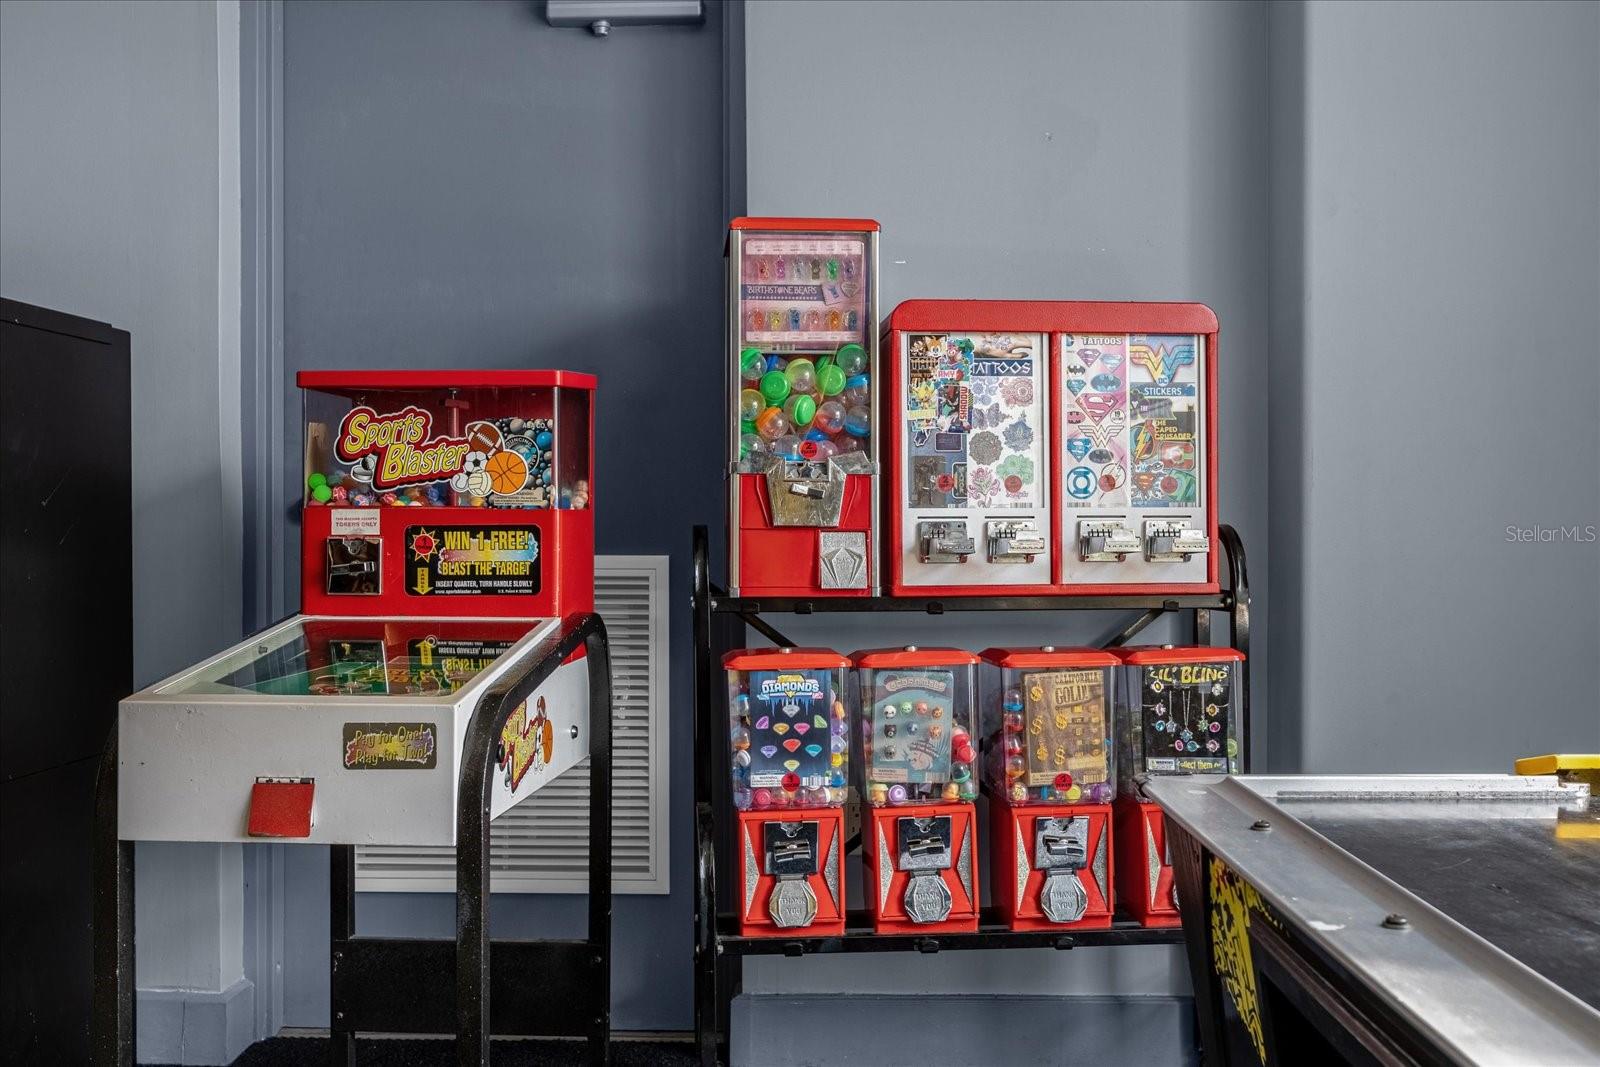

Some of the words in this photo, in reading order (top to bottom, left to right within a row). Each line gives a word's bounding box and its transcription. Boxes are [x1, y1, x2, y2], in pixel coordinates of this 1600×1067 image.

[794, 286, 818, 296] BEARS
[1082, 336, 1122, 346] TATTOOS
[971, 361, 1031, 375] TATTOOS
[1143, 387, 1182, 396] STICKERS
[960, 386, 968, 420] SHADOW
[344, 413, 426, 454] Sports
[382, 442, 470, 481] Blaster
[443, 531, 471, 550] WIN
[476, 531, 485, 551] 1
[490, 531, 529, 550] FREE!
[442, 561, 471, 576] BLAST
[474, 561, 493, 576] THE
[494, 561, 531, 576] TARGET
[1055, 672, 1098, 685] CALIFORNIA
[1181, 666, 1228, 684] BLING
[761, 682, 820, 693] DIAMONDS
[1055, 685, 1088, 705] GOLD!
[355, 730, 376, 748] Pay
[377, 731, 393, 744] for
[397, 724, 424, 742] One!
[355, 749, 378, 766] Play
[382, 750, 398, 762] for
[402, 742, 428, 761] Two!
[1197, 760, 1213, 769] them
[922, 903, 937, 911] YOU
[1057, 901, 1073, 909] YOU
